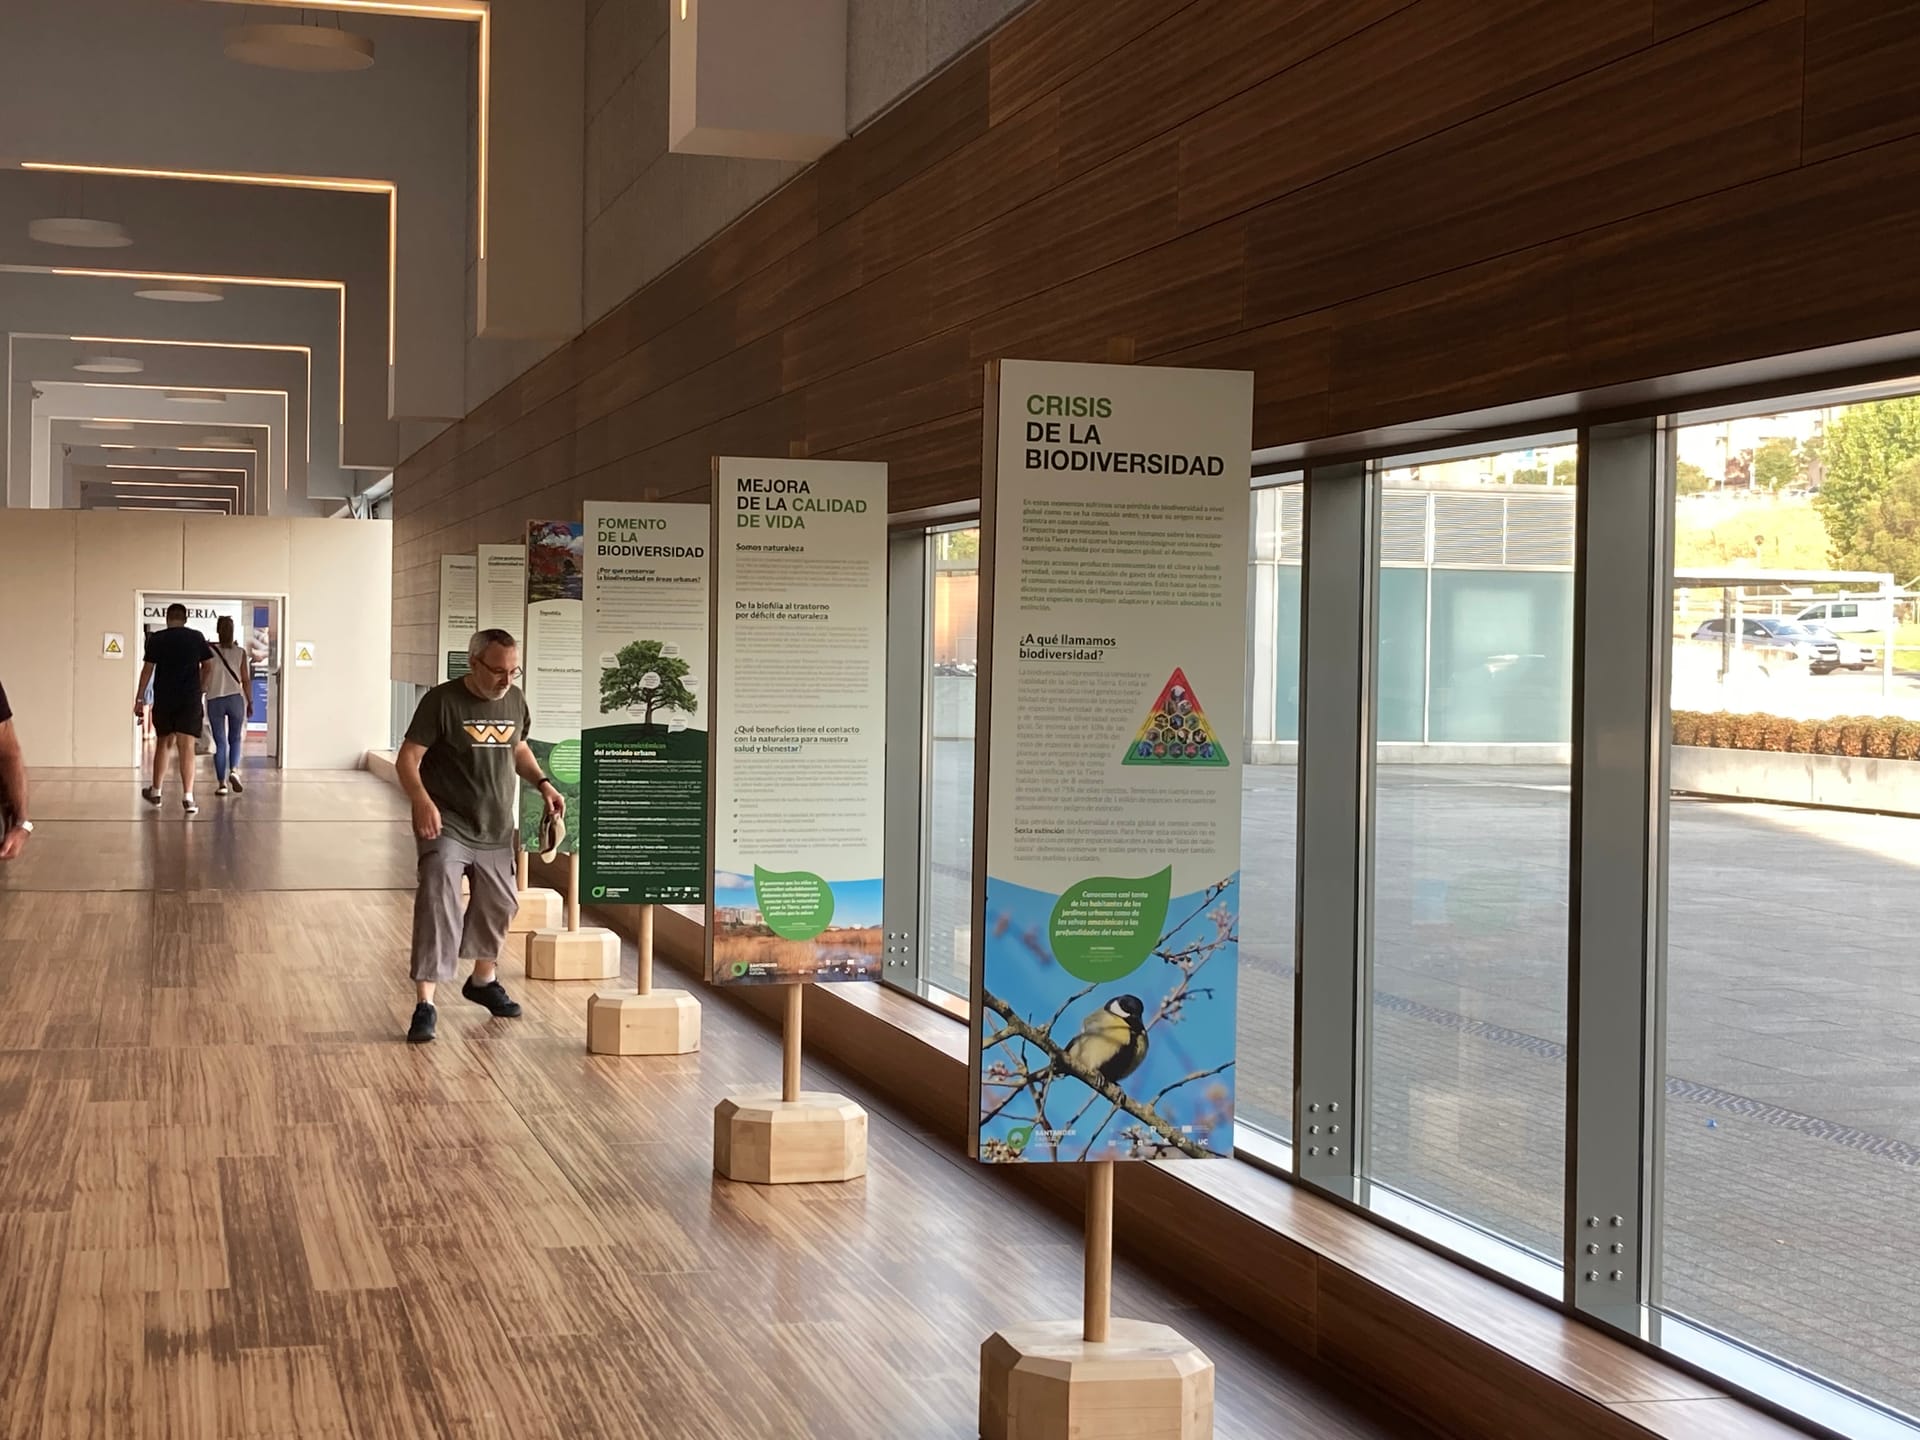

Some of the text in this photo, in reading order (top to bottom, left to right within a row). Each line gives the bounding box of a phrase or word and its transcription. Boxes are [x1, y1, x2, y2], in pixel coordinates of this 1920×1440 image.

[1026, 394, 1112, 418] CRISIS
[1026, 422, 1101, 445] DE LA
[1025, 449, 1224, 476] BIODIVERSIDAD
[737, 478, 810, 494] MEJORA
[737, 496, 867, 513] DE LA CALIDAD
[598, 518, 667, 530] FOMENTO
[737, 514, 805, 529] DE VIDA
[598, 532, 638, 543] DE LA
[597, 545, 704, 558] BIODIVERSIDAD
[736, 543, 804, 552] Somos naturaleza
[597, 567, 610, 576] ¿Por
[612, 568, 623, 576] qué
[757, 602, 784, 610] biofilia
[785, 602, 792, 610] al
[144, 607, 217, 618] CAFERIA
[750, 611, 775, 620] déficit
[776, 612, 786, 620] de
[787, 612, 828, 620] naturaleza
[1019, 634, 1116, 647] ¿A qué llamamos
[1019, 649, 1104, 660] biodiversidad?
[734, 726, 754, 734] ¿Qué
[756, 726, 795, 734] beneficios
[797, 726, 816, 734] tiene
[826, 726, 860, 734] contacto
[756, 746, 761, 754] y
[762, 745, 802, 753] bienestar?
[1056, 928, 1100, 938] profundidades
[1101, 928, 1110, 936] del
